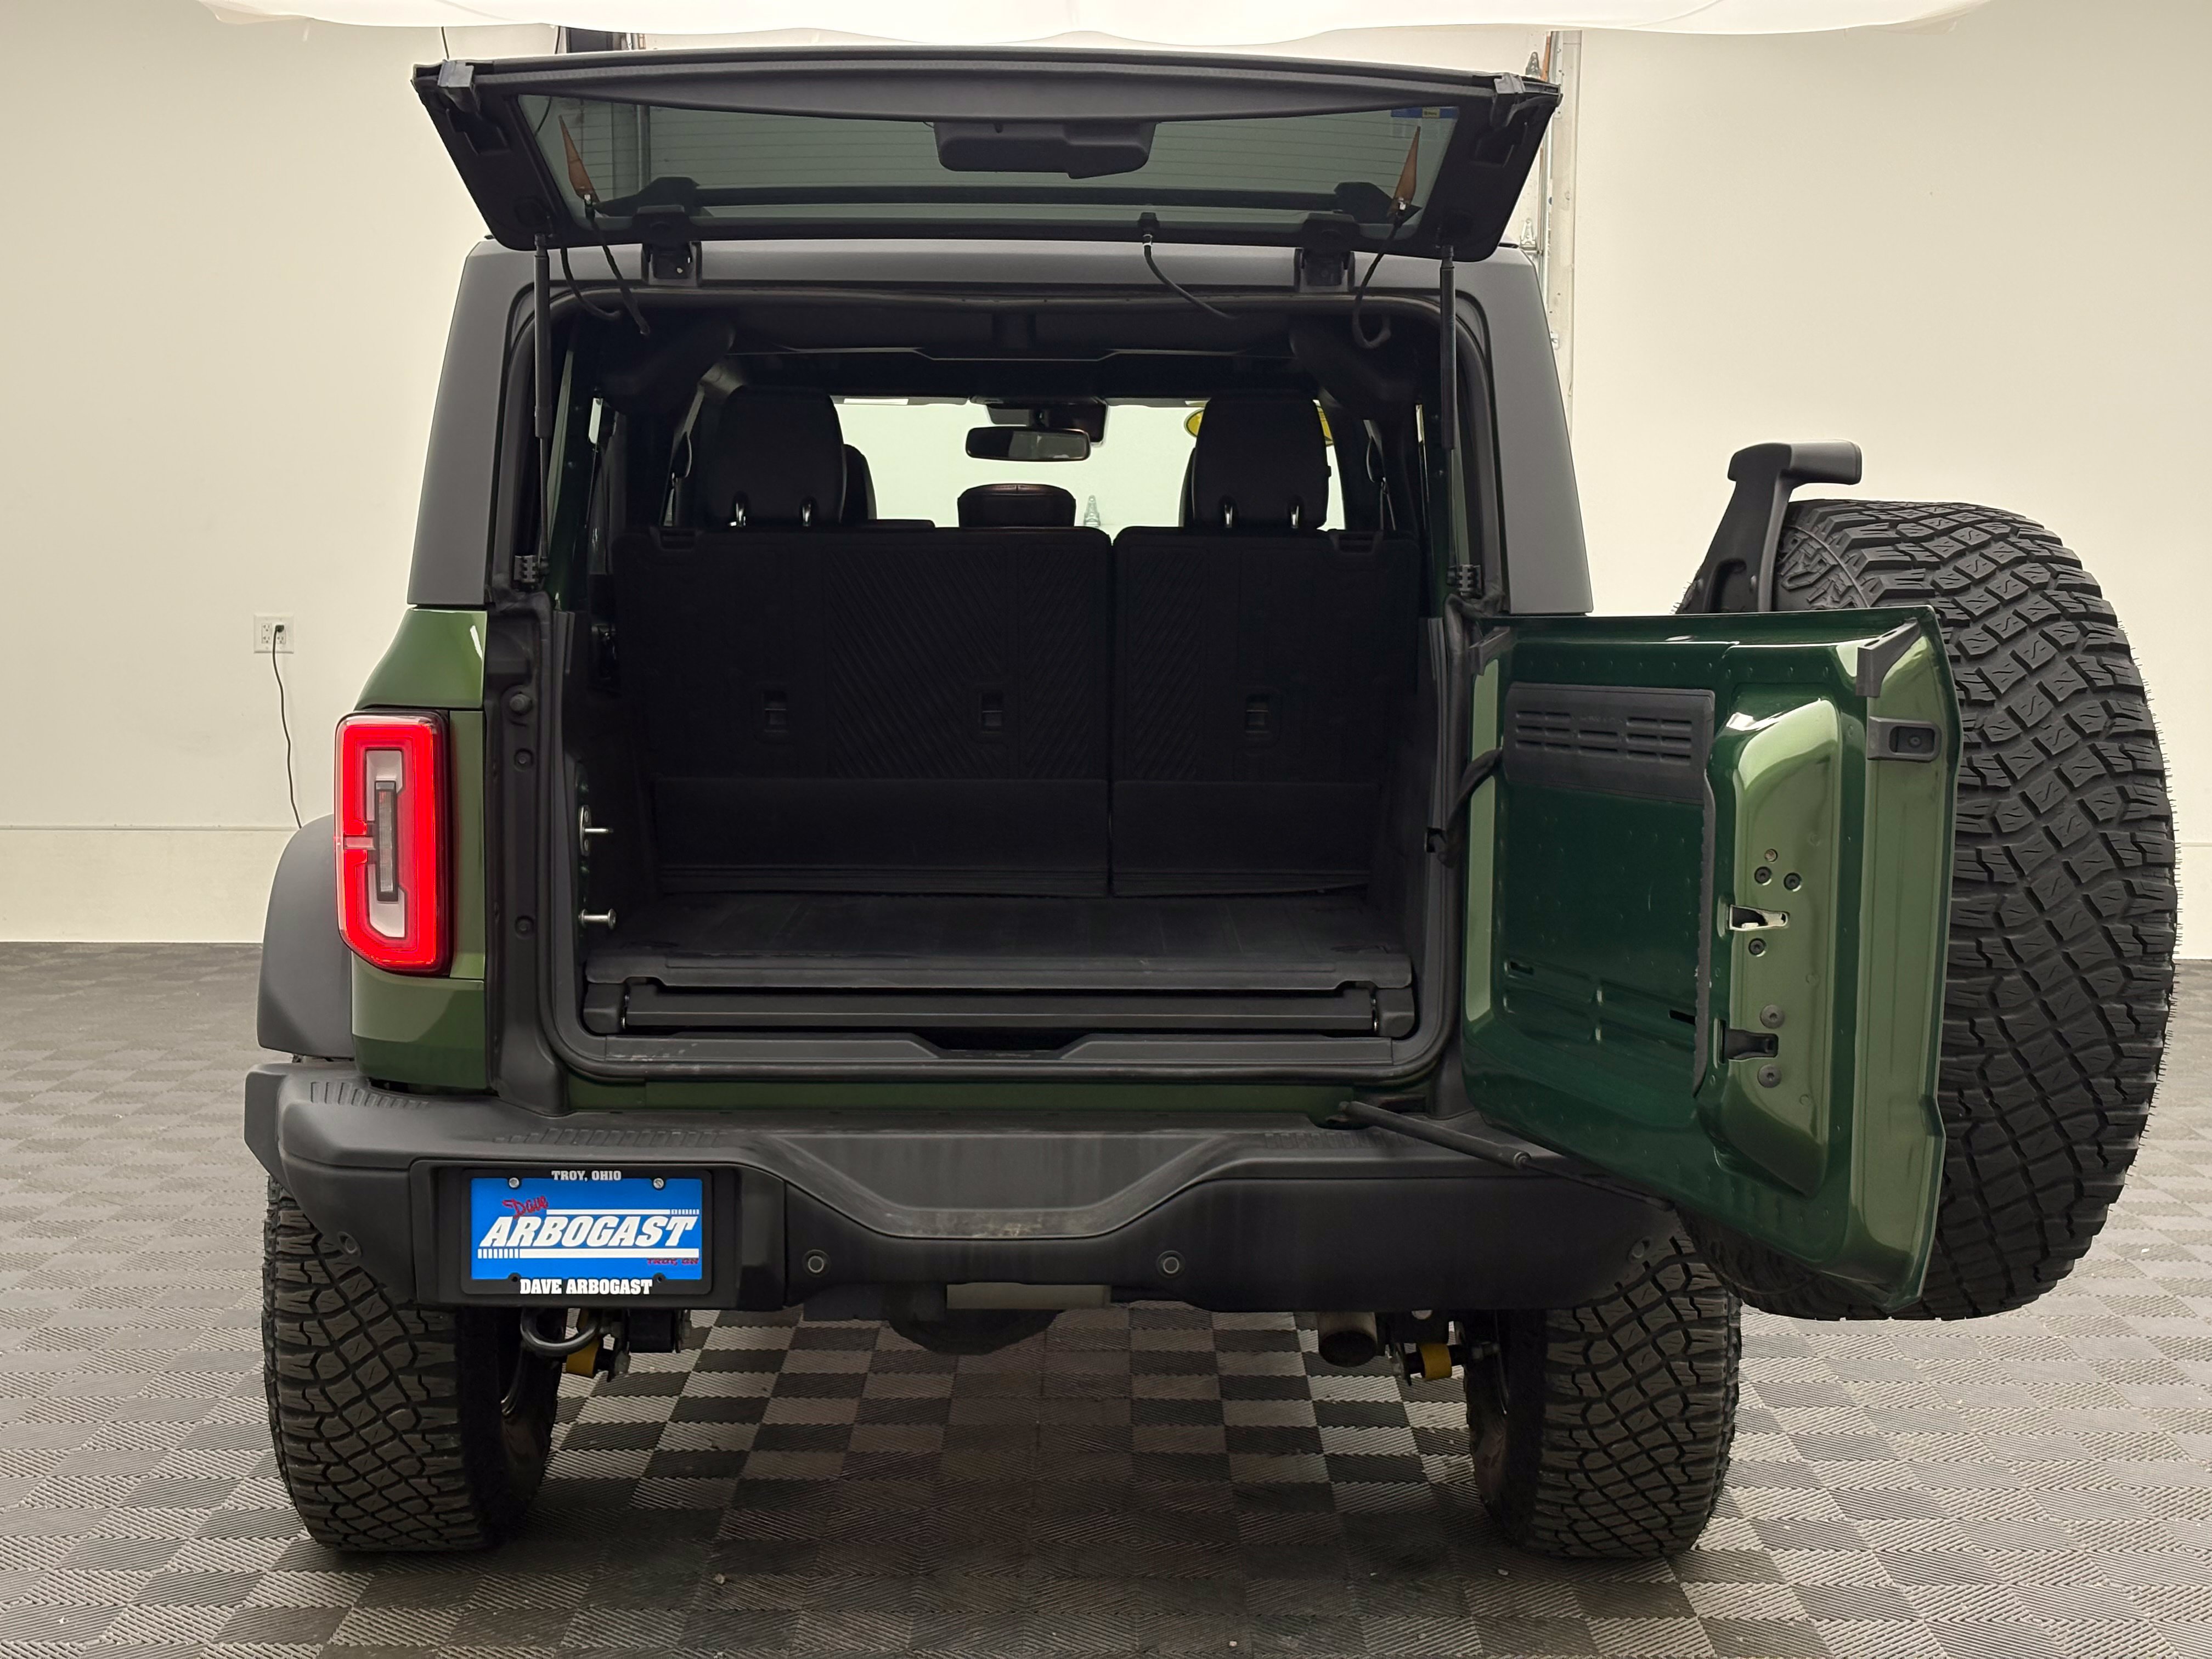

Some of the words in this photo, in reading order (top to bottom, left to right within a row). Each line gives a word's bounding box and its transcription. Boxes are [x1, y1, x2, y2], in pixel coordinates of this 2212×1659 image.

[551, 1170, 588, 1182] TROY,
[591, 1170, 622, 1181] OHIO
[502, 1195, 549, 1219] Dave
[479, 1216, 698, 1247] ARBOGAST
[520, 1279, 562, 1295] DAVE
[566, 1279, 653, 1295] ARBOGAST
